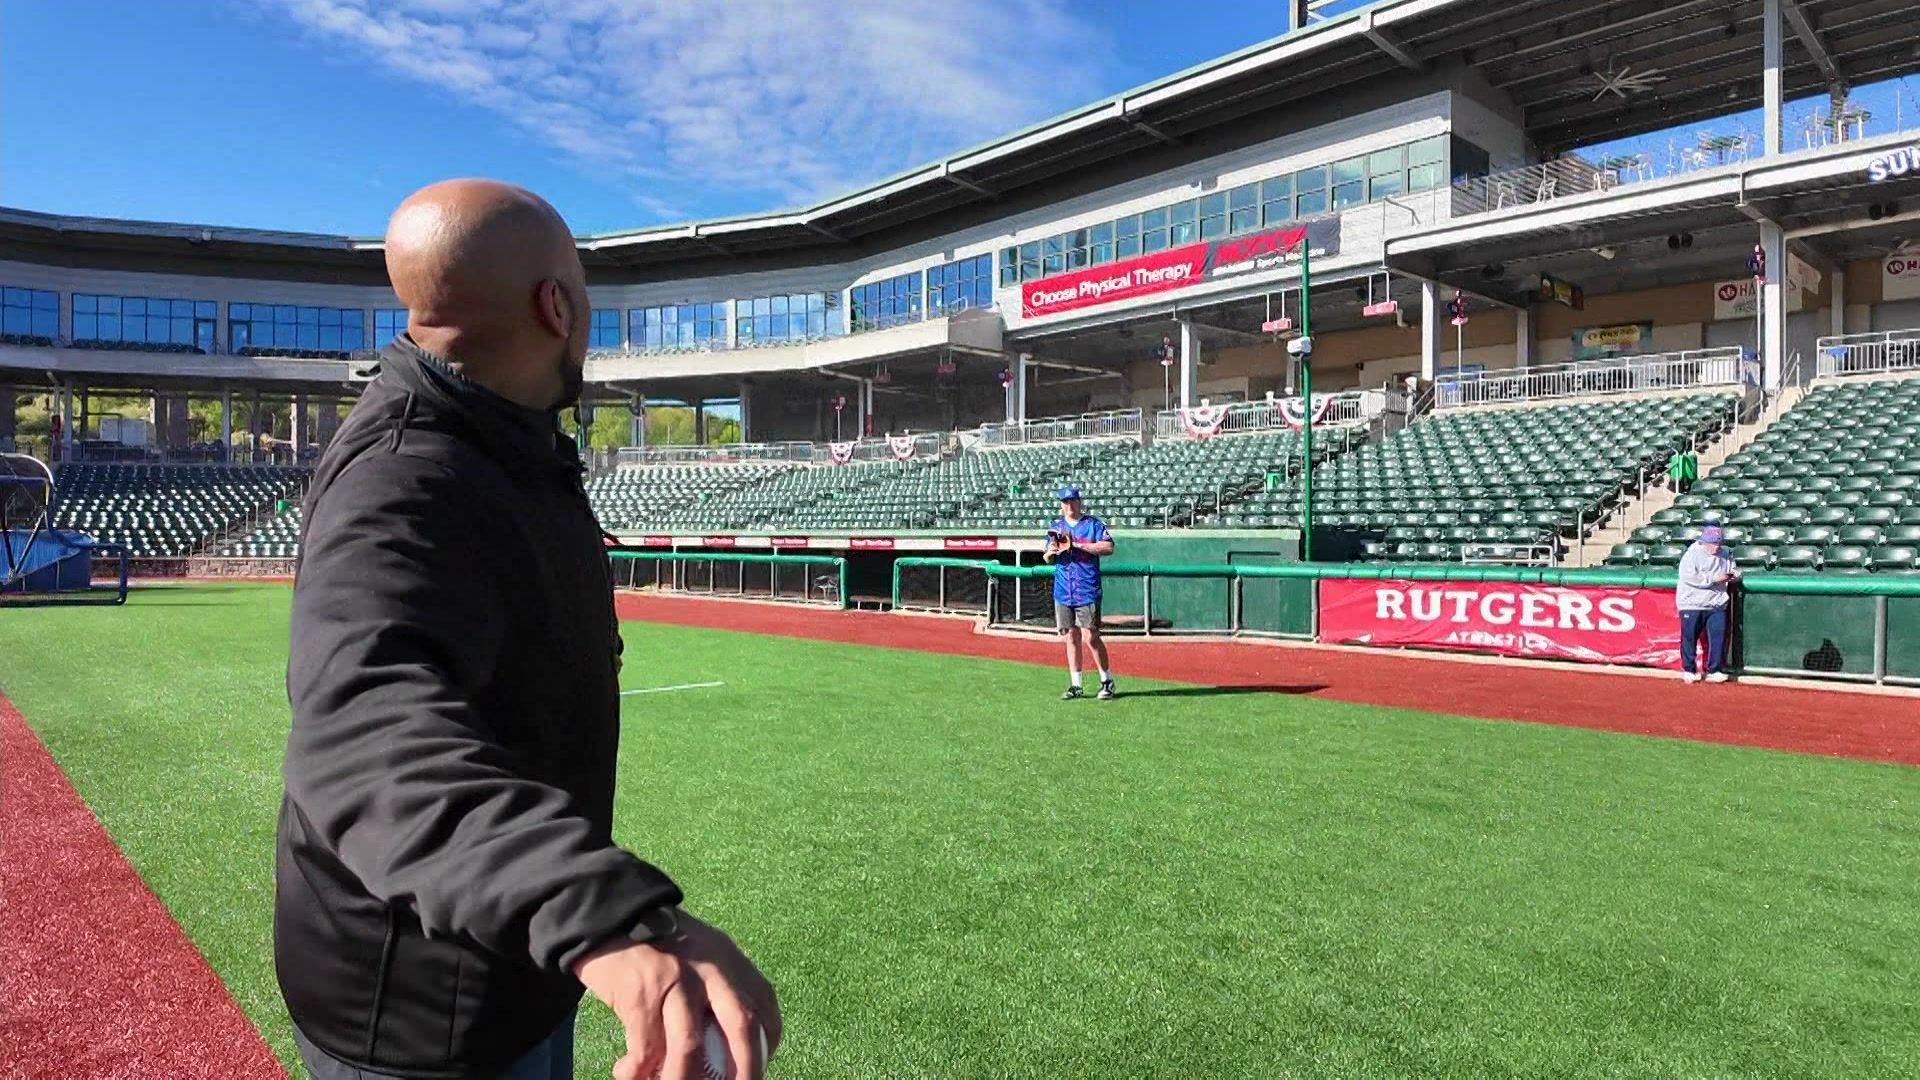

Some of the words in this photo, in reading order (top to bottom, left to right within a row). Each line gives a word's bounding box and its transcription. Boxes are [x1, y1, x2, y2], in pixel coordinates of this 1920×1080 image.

[1031, 287, 1077, 307] Choose
[1079, 272, 1131, 299] Physical
[1133, 262, 1192, 285] Therapy
[1375, 588, 1636, 633] RUTGERS
